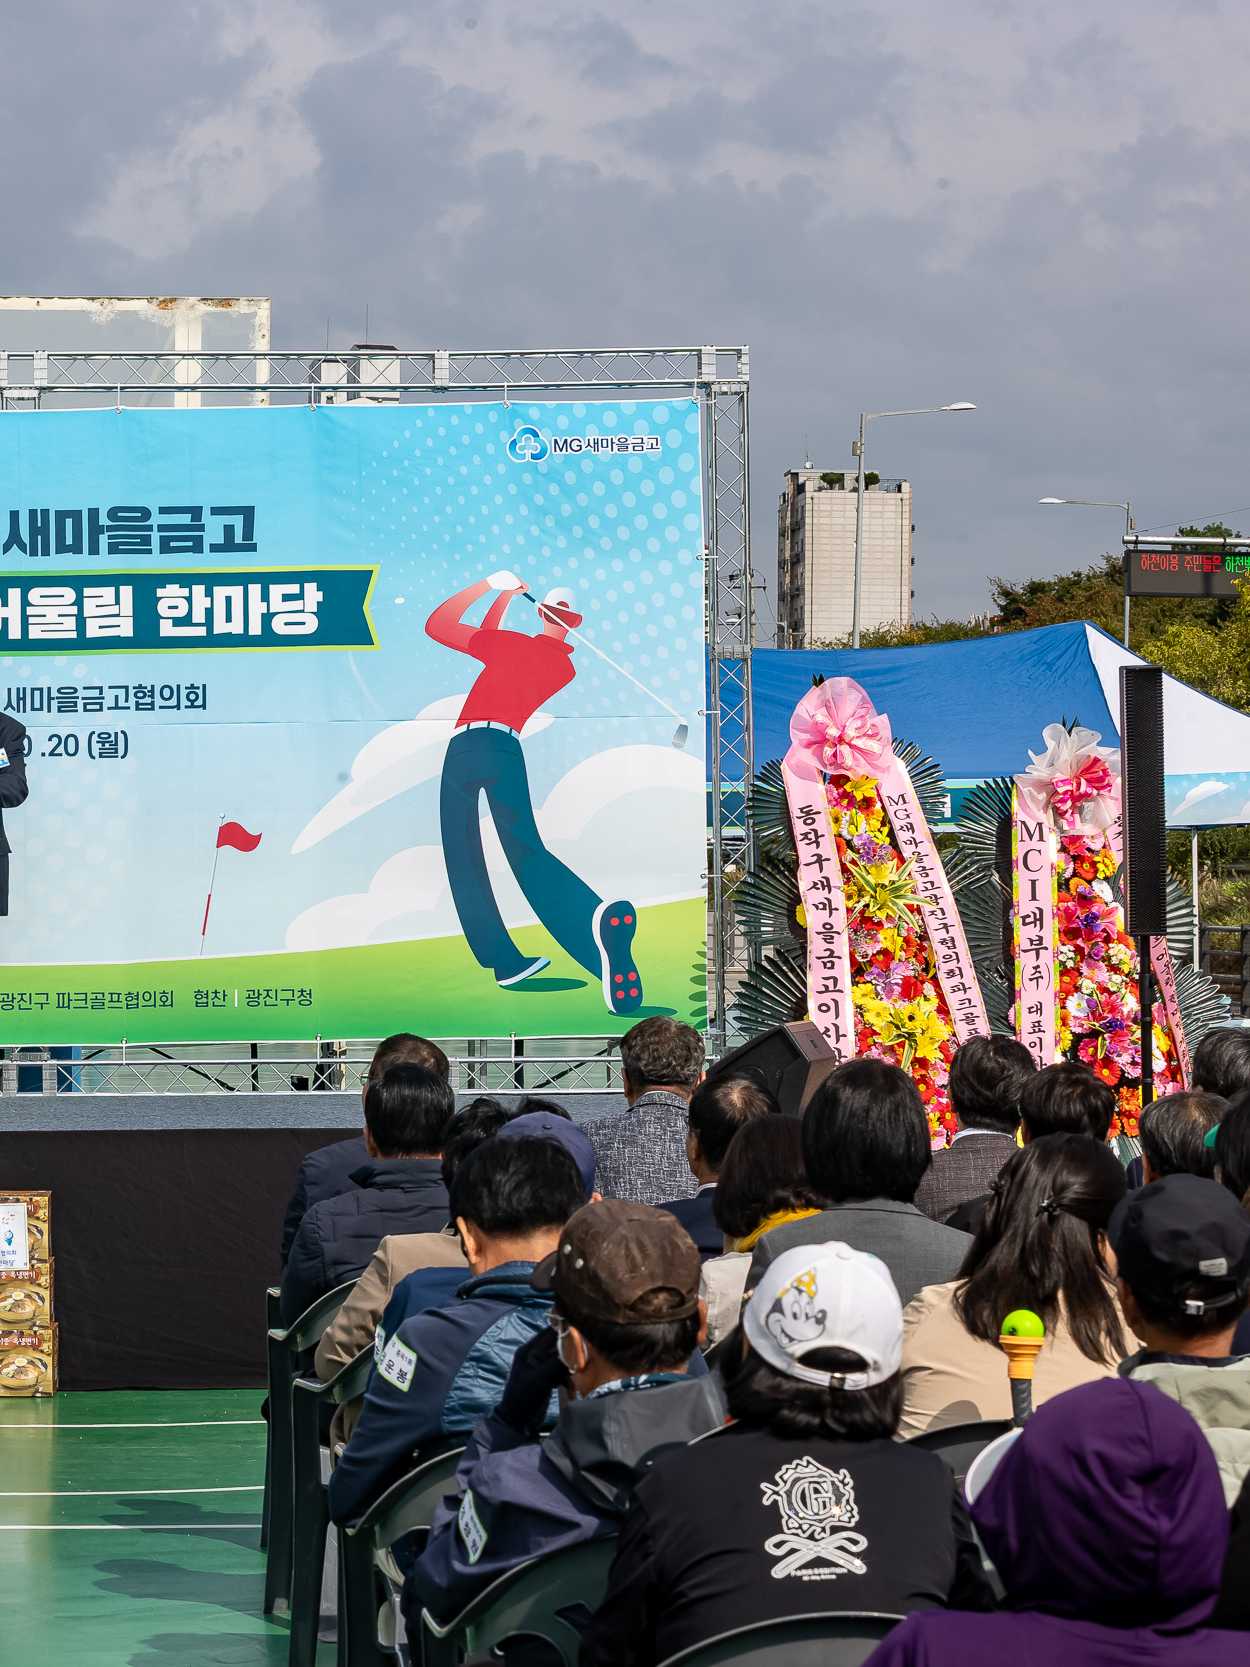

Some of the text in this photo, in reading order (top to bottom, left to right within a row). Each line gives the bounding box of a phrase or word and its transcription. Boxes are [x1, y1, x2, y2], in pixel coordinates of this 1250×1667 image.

[553, 437, 661, 453] MG새마을금고
[1141, 554, 1179, 571] 하천이용
[1184, 555, 1221, 572] 주민들은
[156, 582, 323, 638] 한마당
[3, 683, 207, 714] 새마을금고협의회
[87, 730, 129, 760] (월)
[0, 992, 50, 1011] 광진구
[55, 990, 174, 1010] 파크골프협의회
[193, 989, 228, 1008] 협찬
[245, 988, 313, 1007] 광진구청
